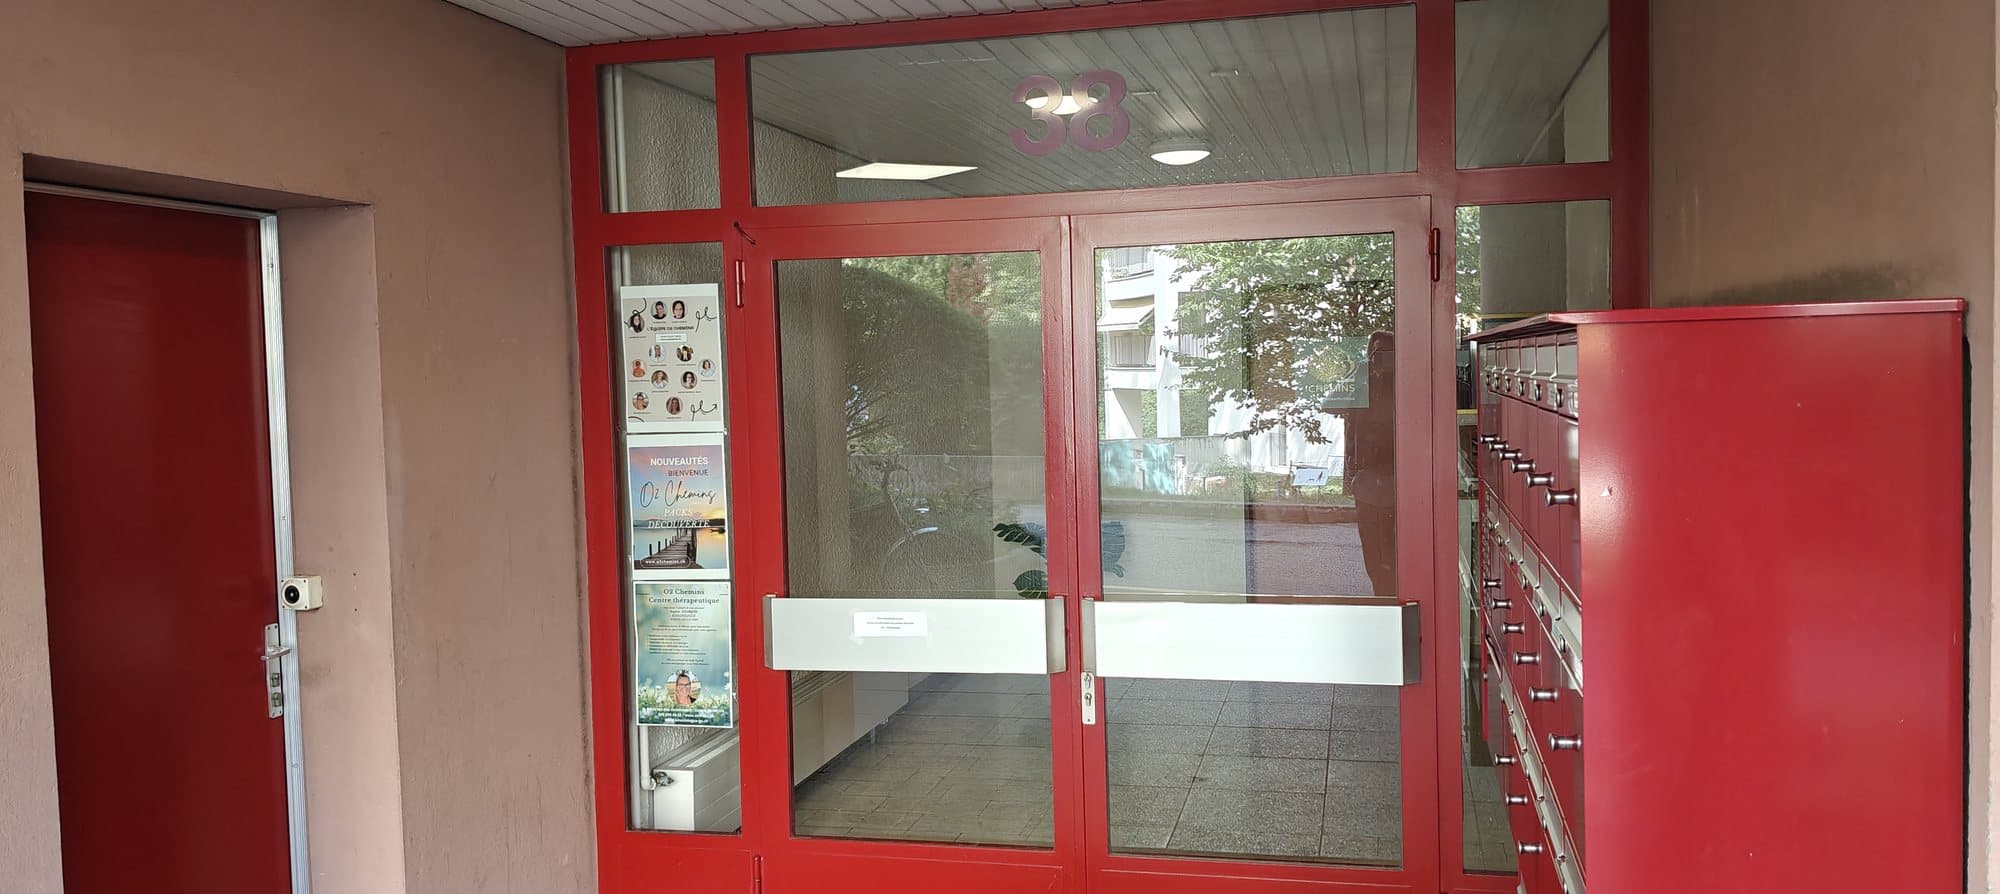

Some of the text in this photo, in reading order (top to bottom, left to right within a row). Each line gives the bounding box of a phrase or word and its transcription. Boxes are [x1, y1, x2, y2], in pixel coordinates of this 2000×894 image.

[1008, 69, 1130, 157] 38
[650, 456, 708, 466] NOUVEAUTÉS
[668, 469, 709, 477] BIENVENUE
[664, 508, 693, 517] PACKS
